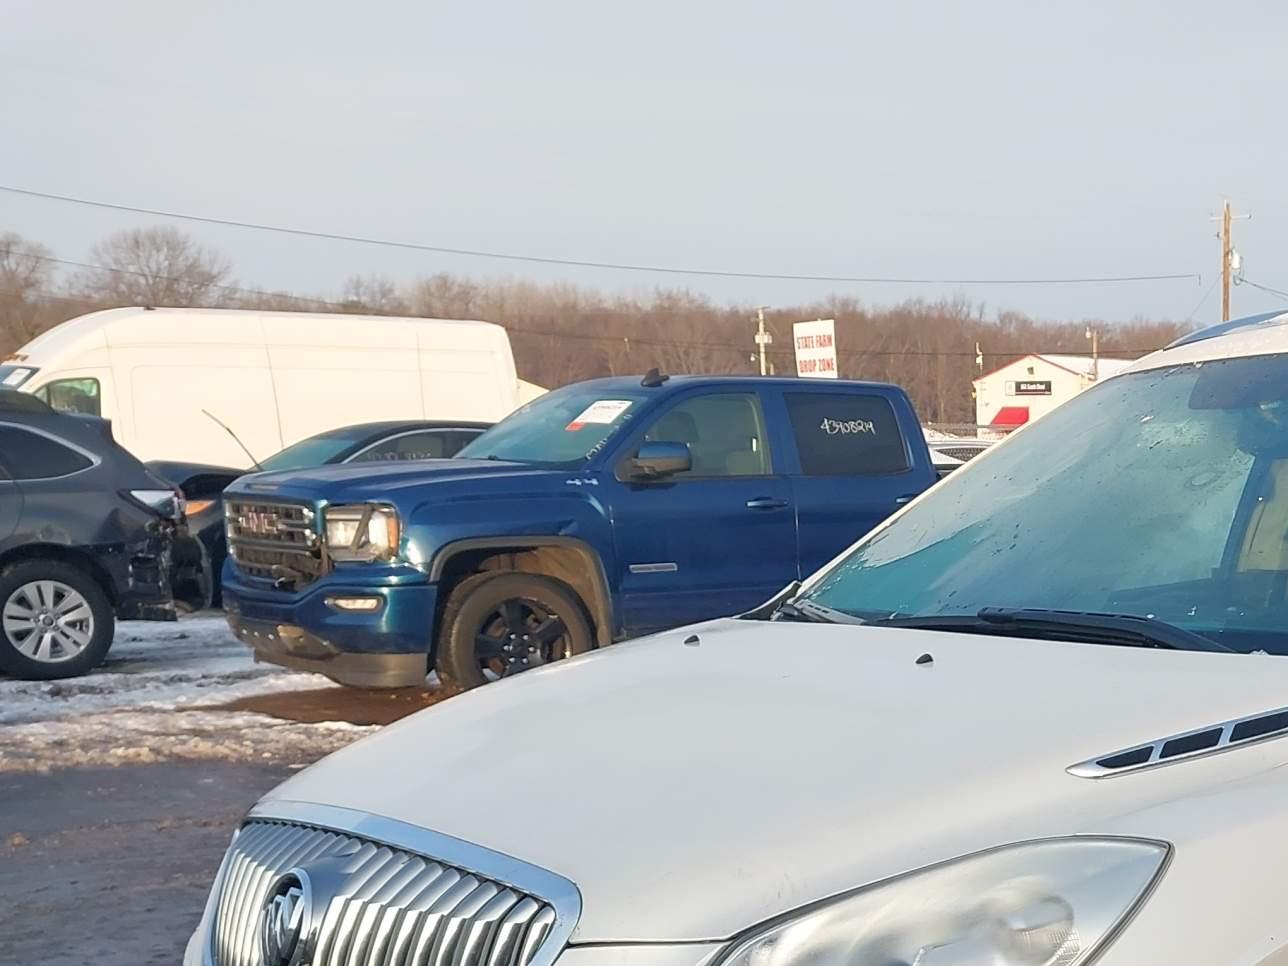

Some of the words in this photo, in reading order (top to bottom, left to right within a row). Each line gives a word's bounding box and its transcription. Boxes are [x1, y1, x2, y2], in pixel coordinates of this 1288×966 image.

[797, 336, 814, 350] STATE
[815, 334, 833, 348] FARM
[800, 359, 817, 373] DROP
[818, 358, 835, 372] ZONE
